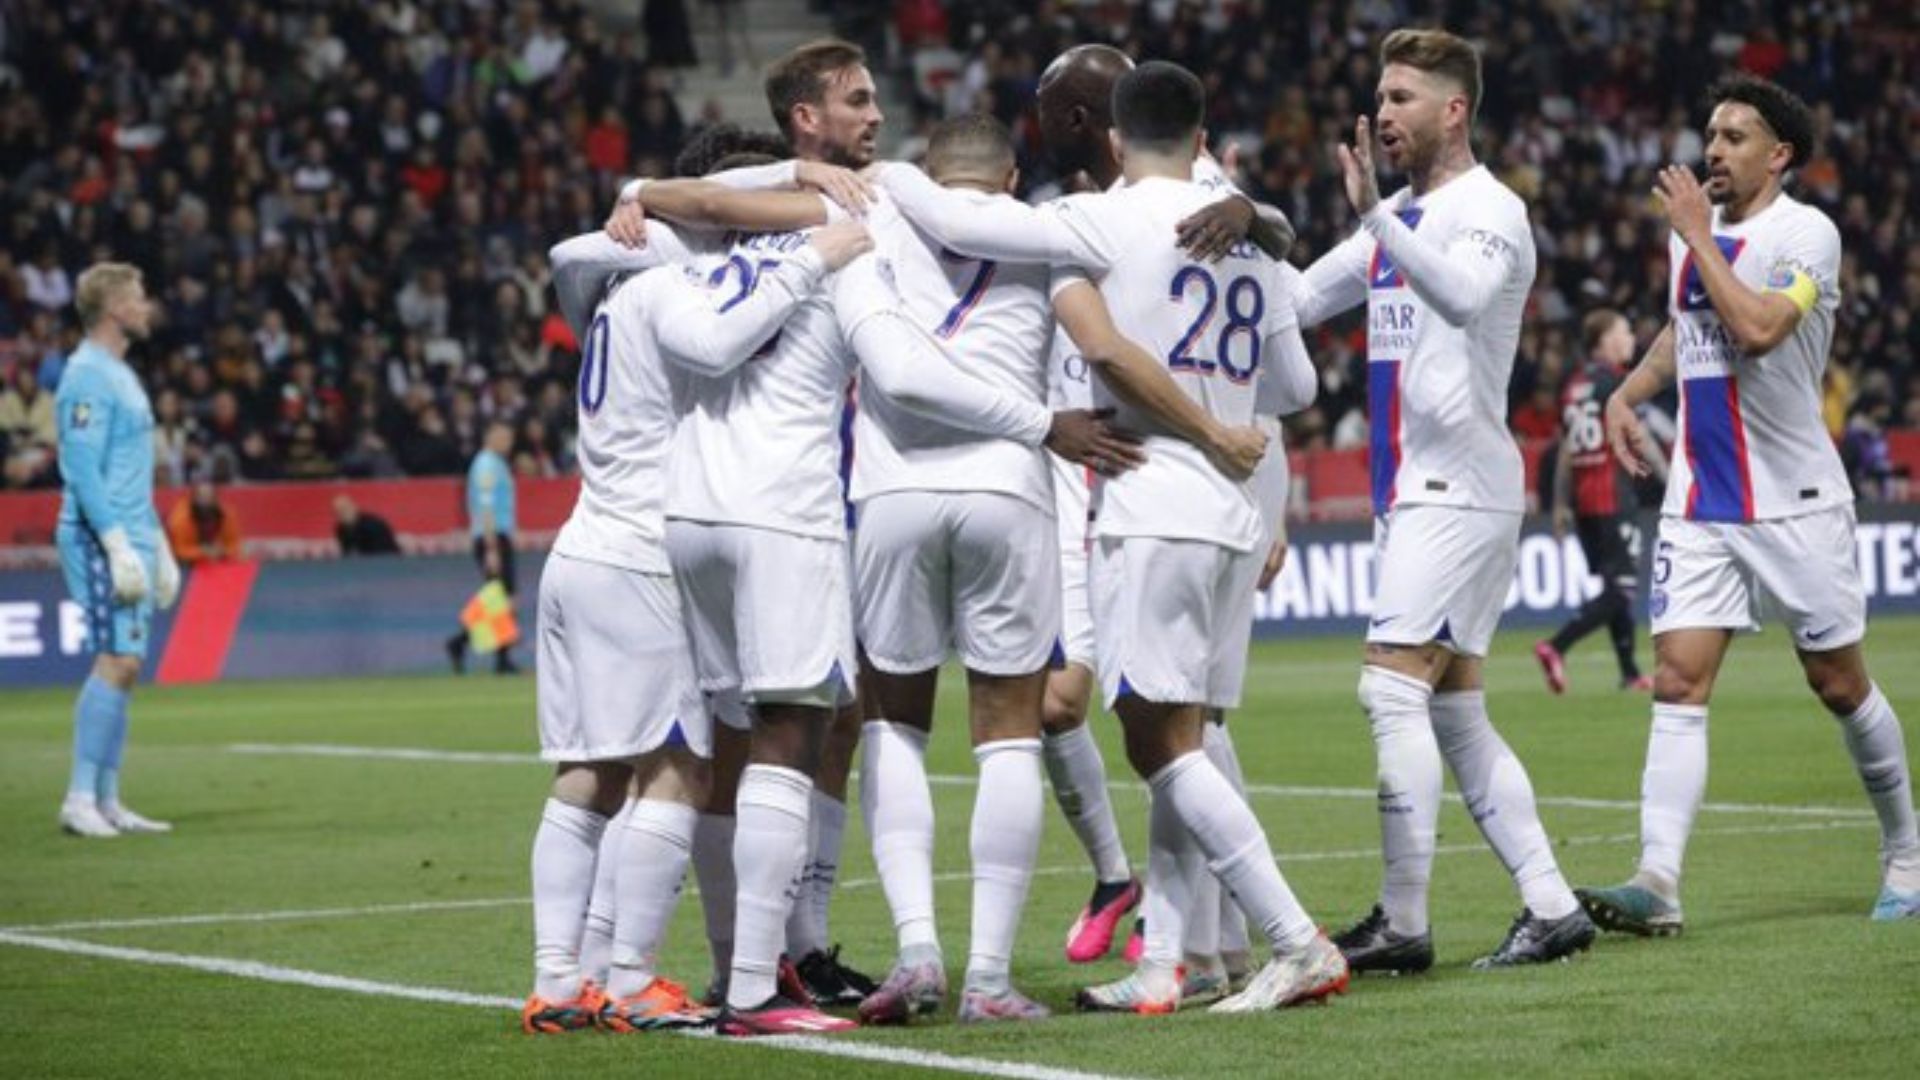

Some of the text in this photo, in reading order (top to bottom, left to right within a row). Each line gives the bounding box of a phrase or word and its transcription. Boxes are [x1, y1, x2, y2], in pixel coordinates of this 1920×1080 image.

[1169, 265, 1266, 386] 28
[1563, 401, 1605, 453] 26
[1254, 542, 1377, 619] AND
[1855, 523, 1920, 596] TE
[1653, 541, 1672, 585] 5
